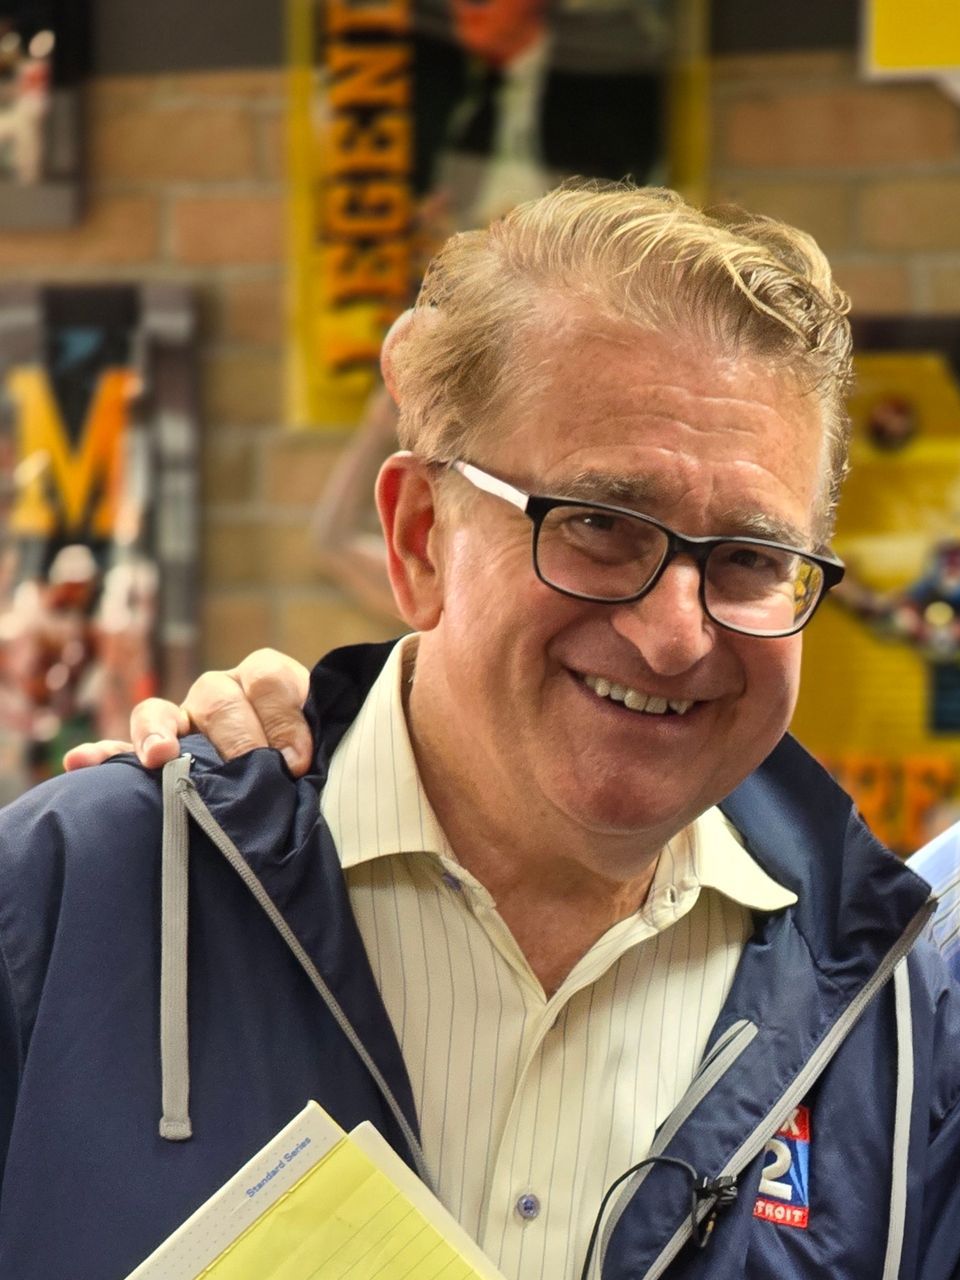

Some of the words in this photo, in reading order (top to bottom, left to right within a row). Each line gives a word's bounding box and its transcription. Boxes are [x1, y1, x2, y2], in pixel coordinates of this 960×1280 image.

[246, 1160, 285, 1198] Standard
[283, 1137, 312, 1162] Series
[759, 1139, 792, 1200] 2
